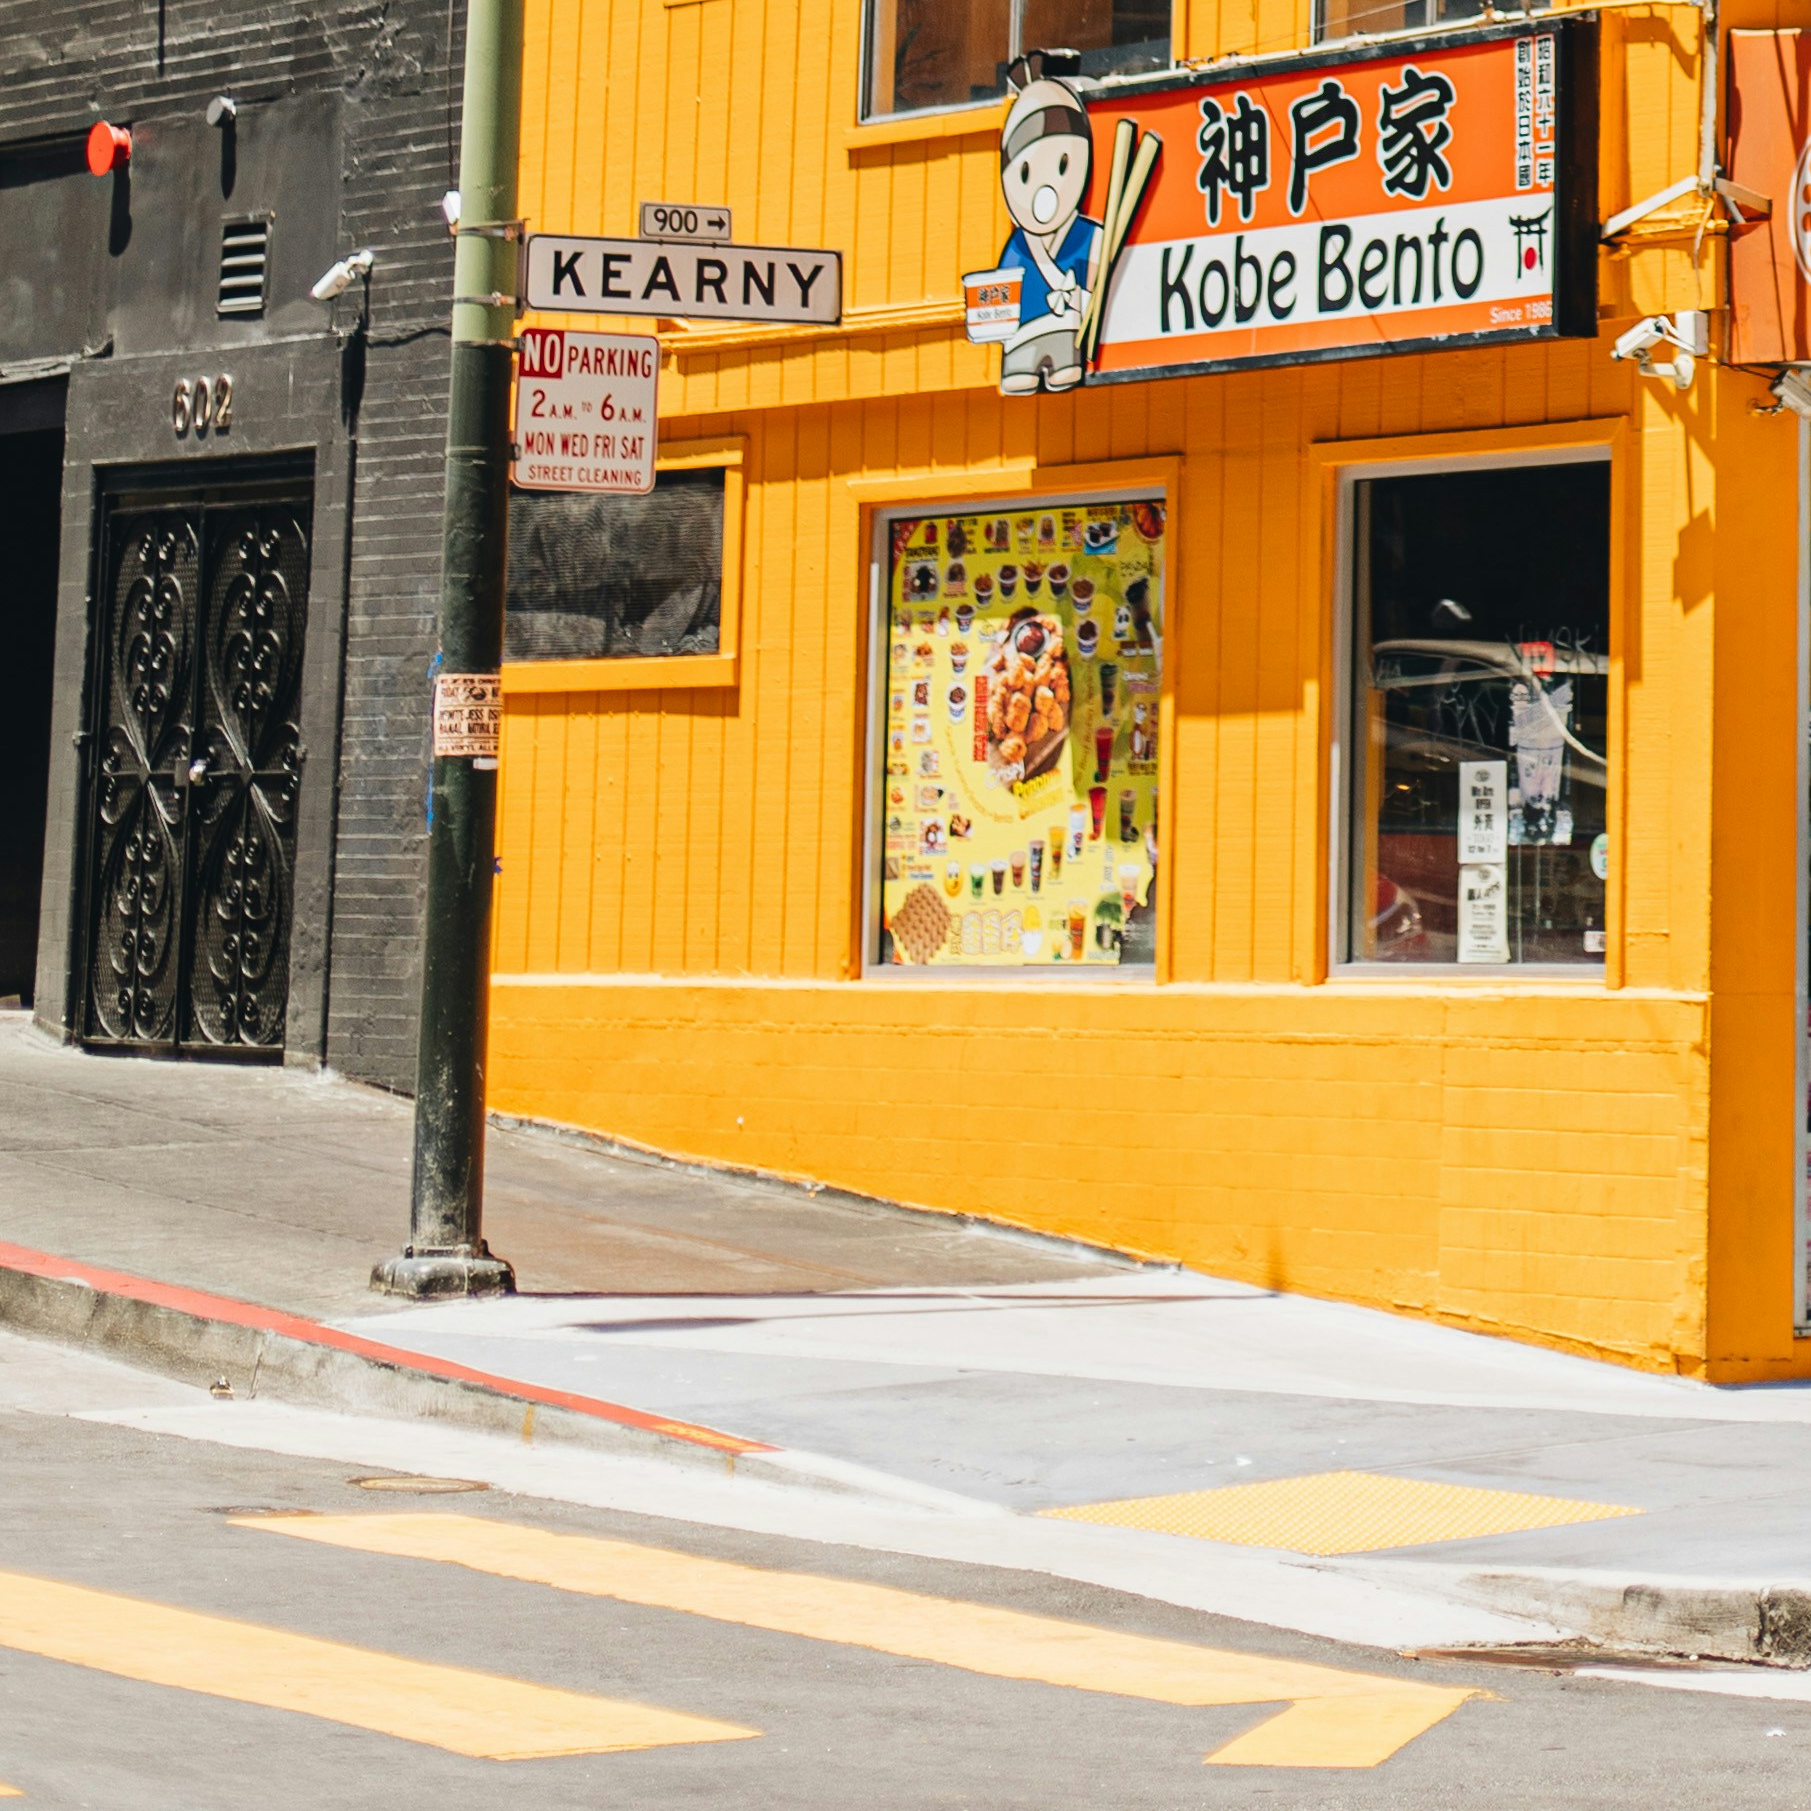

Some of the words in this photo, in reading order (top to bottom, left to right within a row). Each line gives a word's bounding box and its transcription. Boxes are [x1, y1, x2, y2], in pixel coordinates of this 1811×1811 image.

[653, 207, 699, 234] 900
[551, 249, 826, 310] KEARNY
[1160, 234, 1298, 334] Kobe
[1317, 216, 1485, 315] Bento
[1489, 304, 1522, 324] Since
[1524, 300, 1553, 320] 1986
[523, 332, 562, 374] NO
[567, 345, 652, 379] PARKING
[172, 373, 233, 432] 602
[530, 389, 546, 418] 2
[549, 404, 578, 420] A.M.
[600, 393, 615, 422] 6
[618, 408, 647, 424] A.M.
[524, 431, 554, 457] MON
[560, 433, 590, 458] WED
[593, 435, 616, 459] FRI
[620, 436, 645, 461] SAT
[527, 464, 574, 480] STREET
[577, 466, 642, 486] CLEANING
